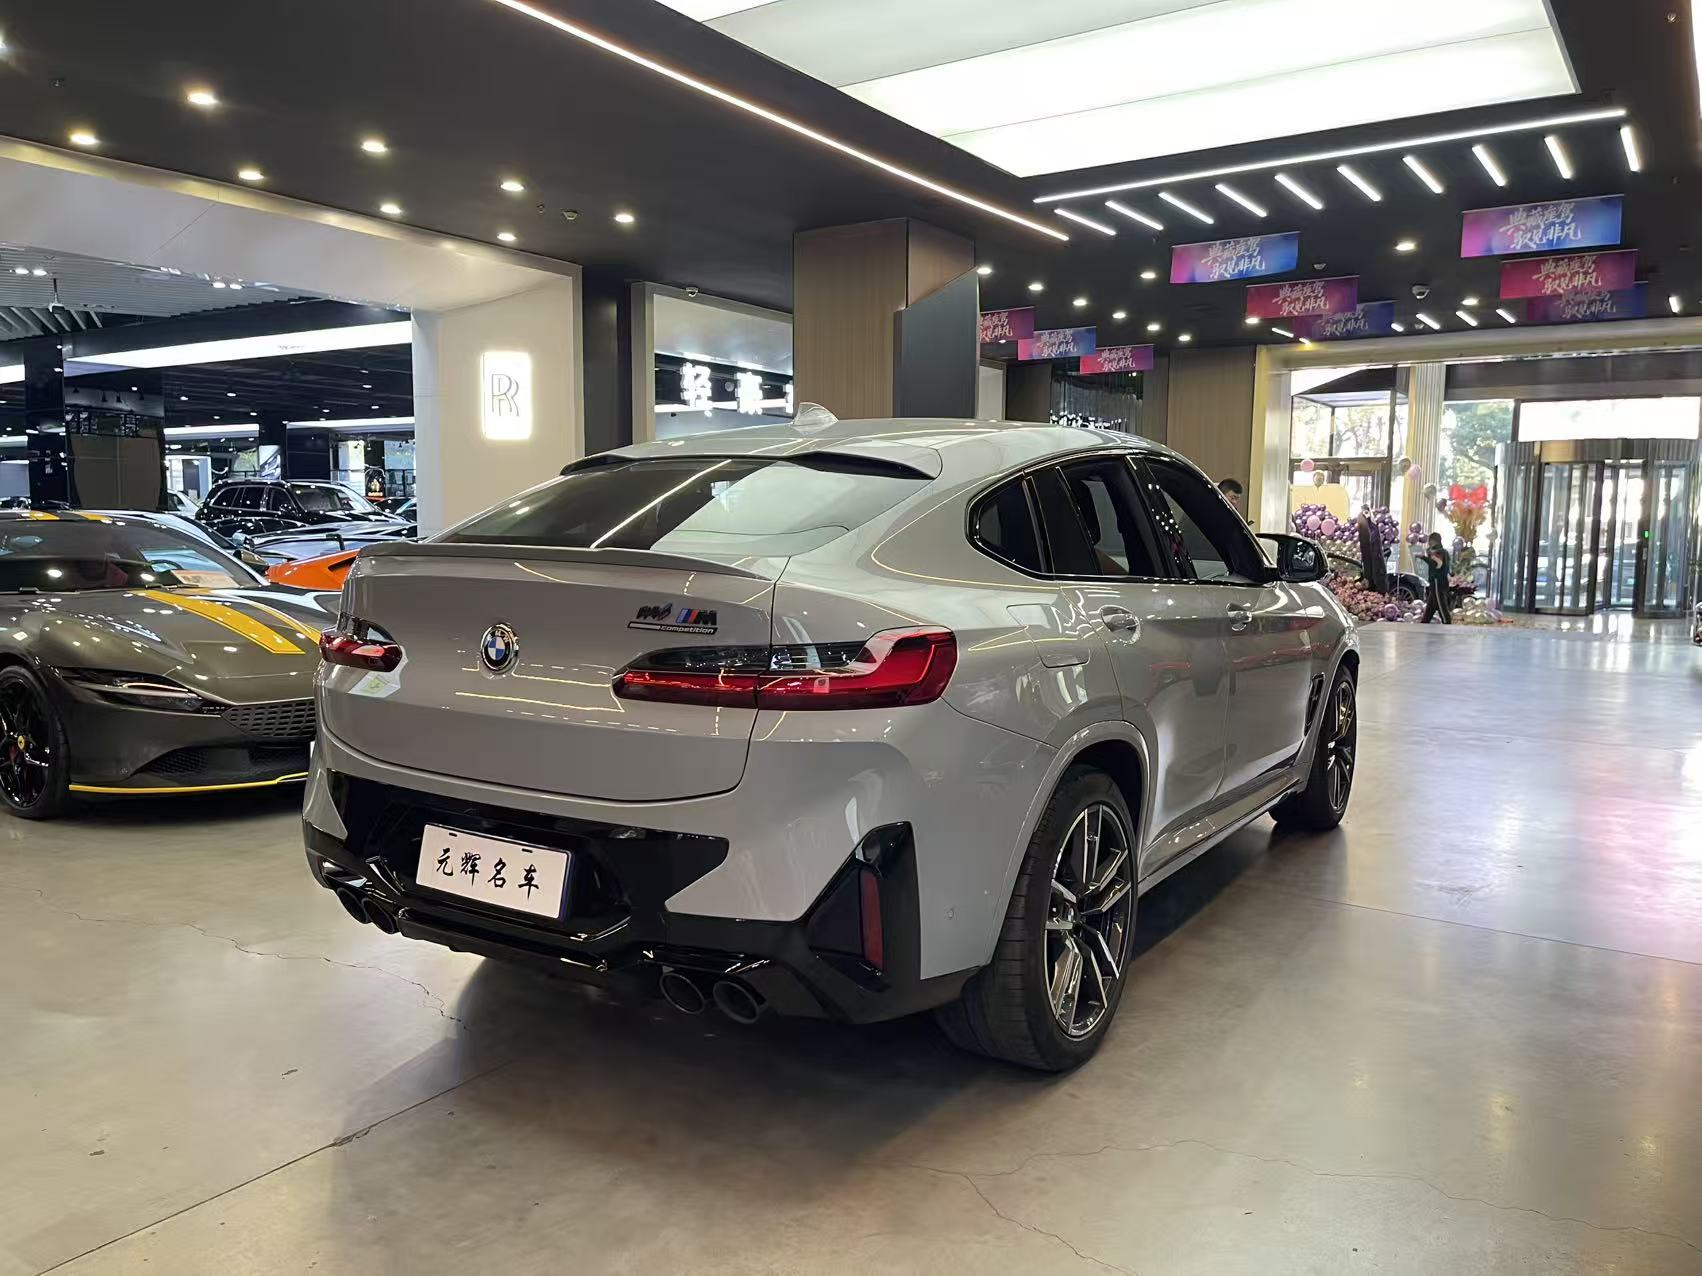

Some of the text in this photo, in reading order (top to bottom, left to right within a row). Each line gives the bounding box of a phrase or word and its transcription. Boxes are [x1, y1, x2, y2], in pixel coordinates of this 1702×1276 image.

[1500, 202, 1576, 234] 典藏座驾
[1201, 238, 1261, 265] 典藏座驾
[436, 848, 540, 900] 元辉名车
